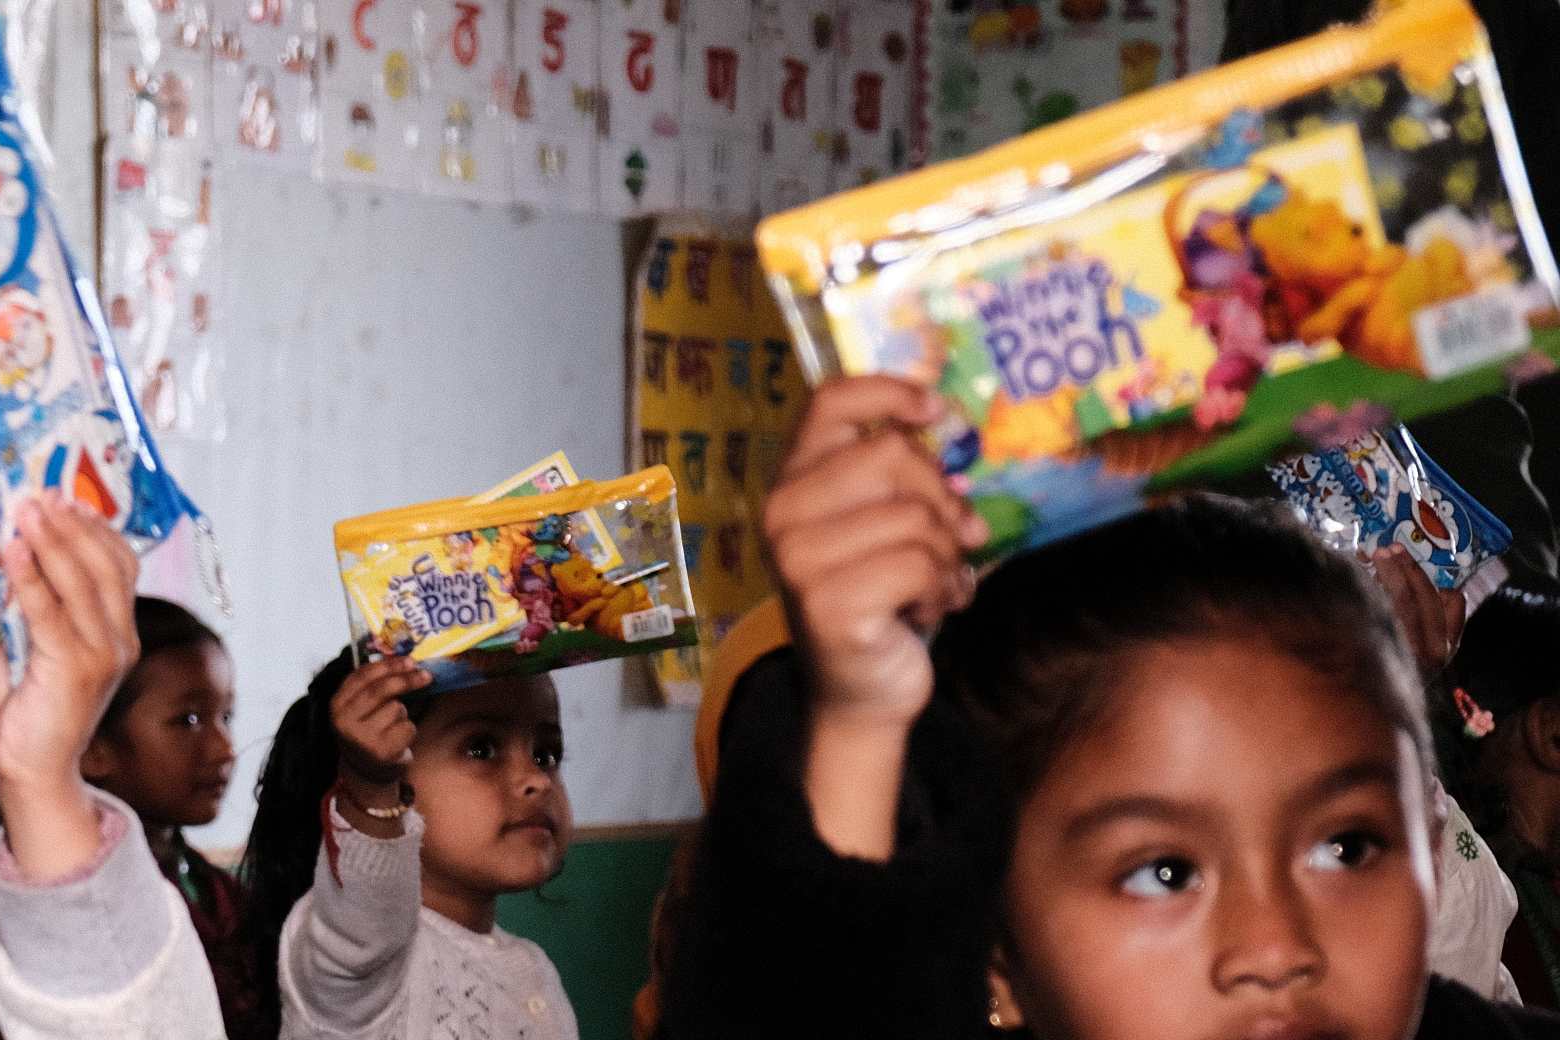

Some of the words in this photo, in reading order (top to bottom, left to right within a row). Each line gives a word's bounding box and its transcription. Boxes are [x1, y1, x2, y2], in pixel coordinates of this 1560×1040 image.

[984, 287, 1144, 401] Pooh
[417, 572, 483, 593] Winnie
[442, 588, 470, 604] the
[421, 580, 496, 630] Pooh
